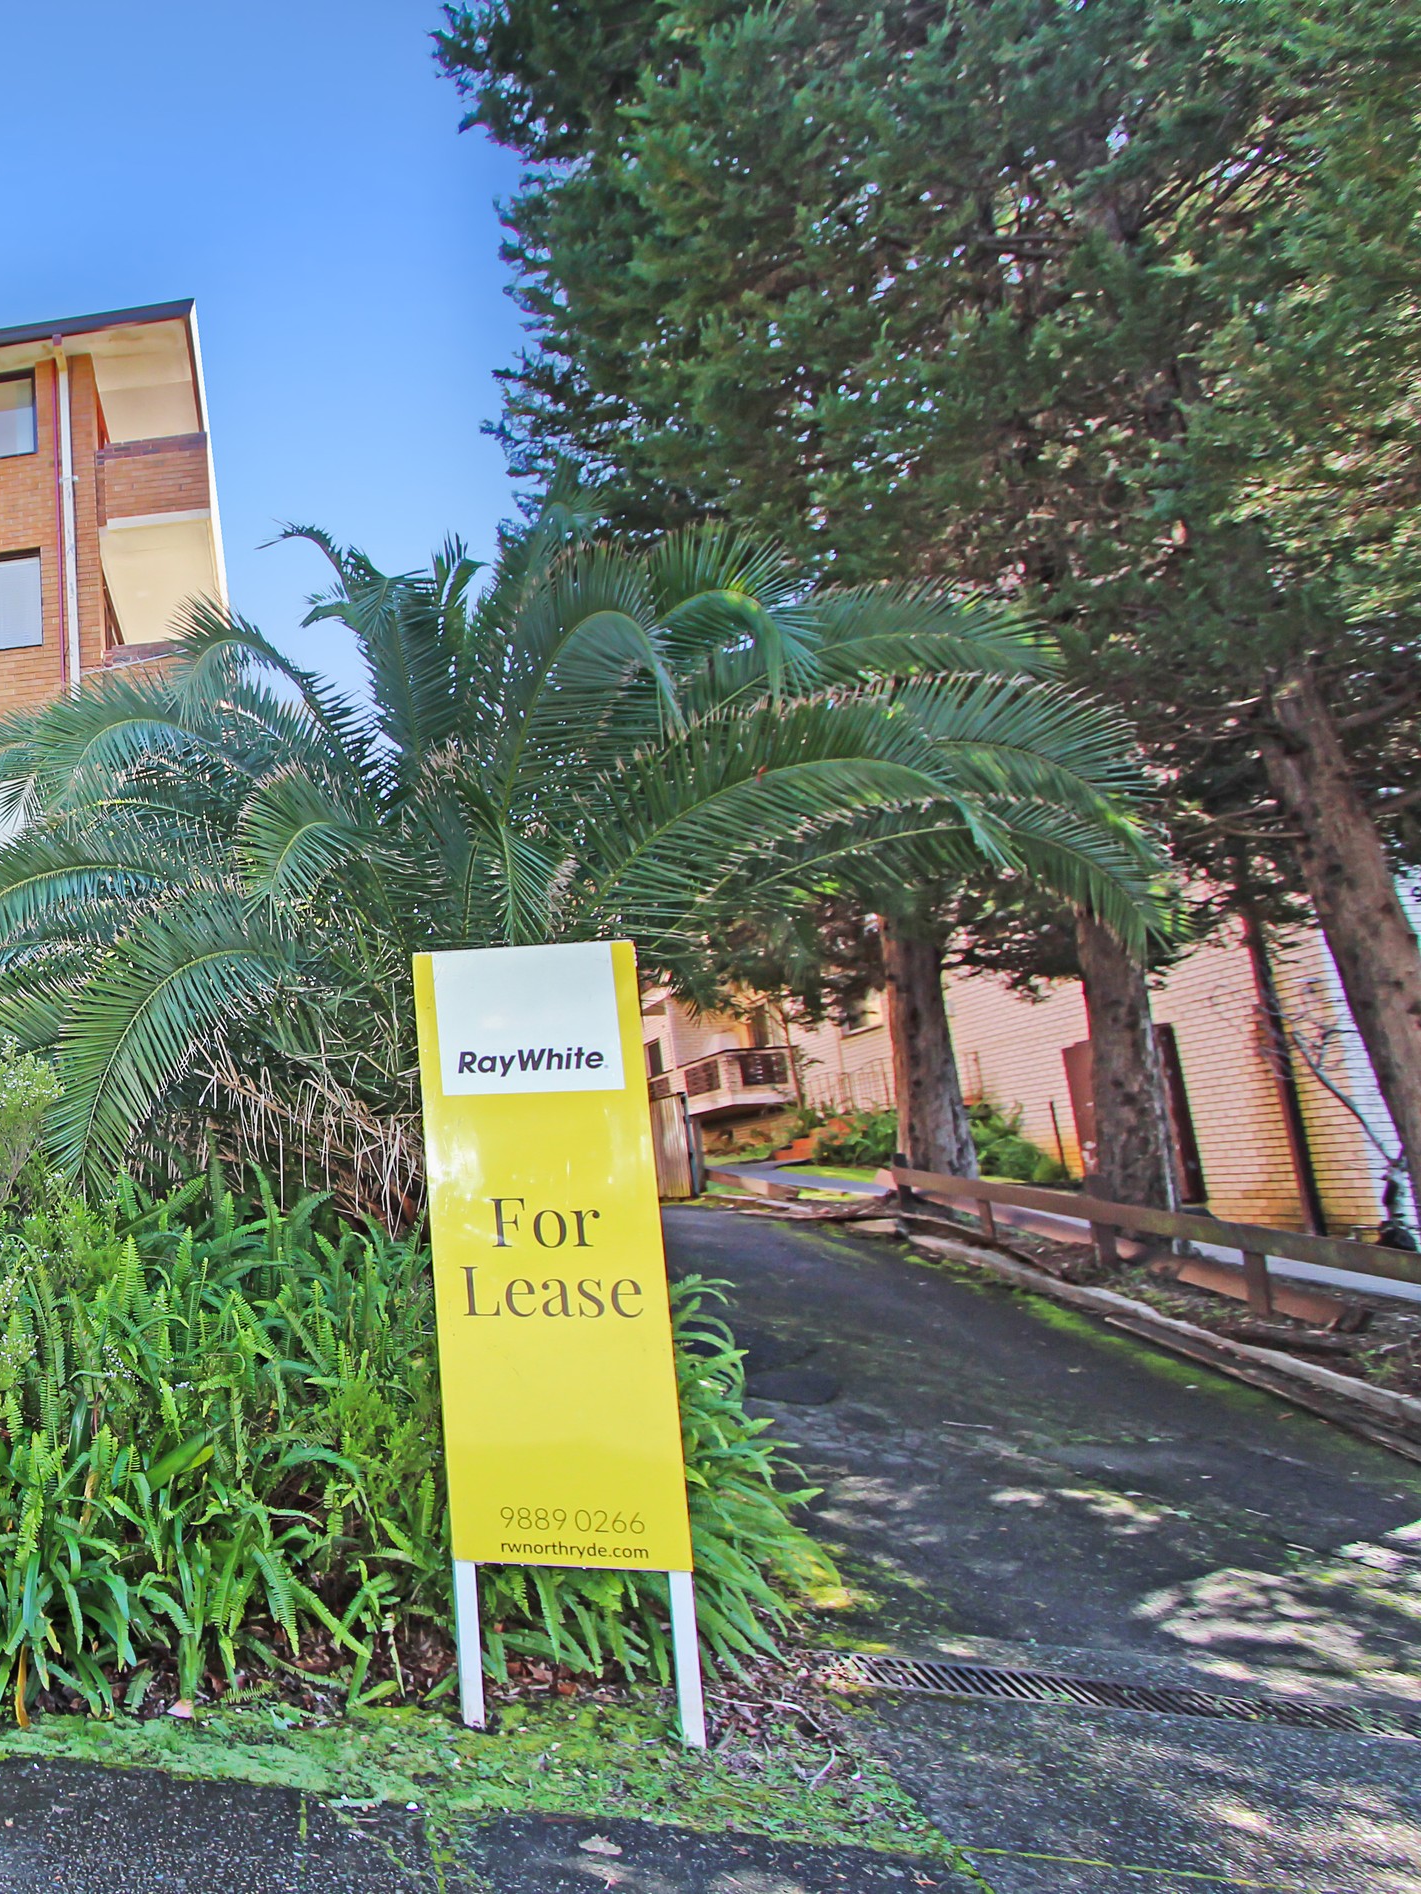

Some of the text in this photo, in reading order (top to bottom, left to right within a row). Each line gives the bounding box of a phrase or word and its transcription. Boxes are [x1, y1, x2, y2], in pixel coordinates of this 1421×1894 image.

[458, 1046, 605, 1077] RayWhite
[490, 1197, 601, 1249] For
[460, 1266, 644, 1319] Lease
[500, 1506, 646, 1535] 9889 0266
[500, 1541, 650, 1559] rwnorthryde.com
